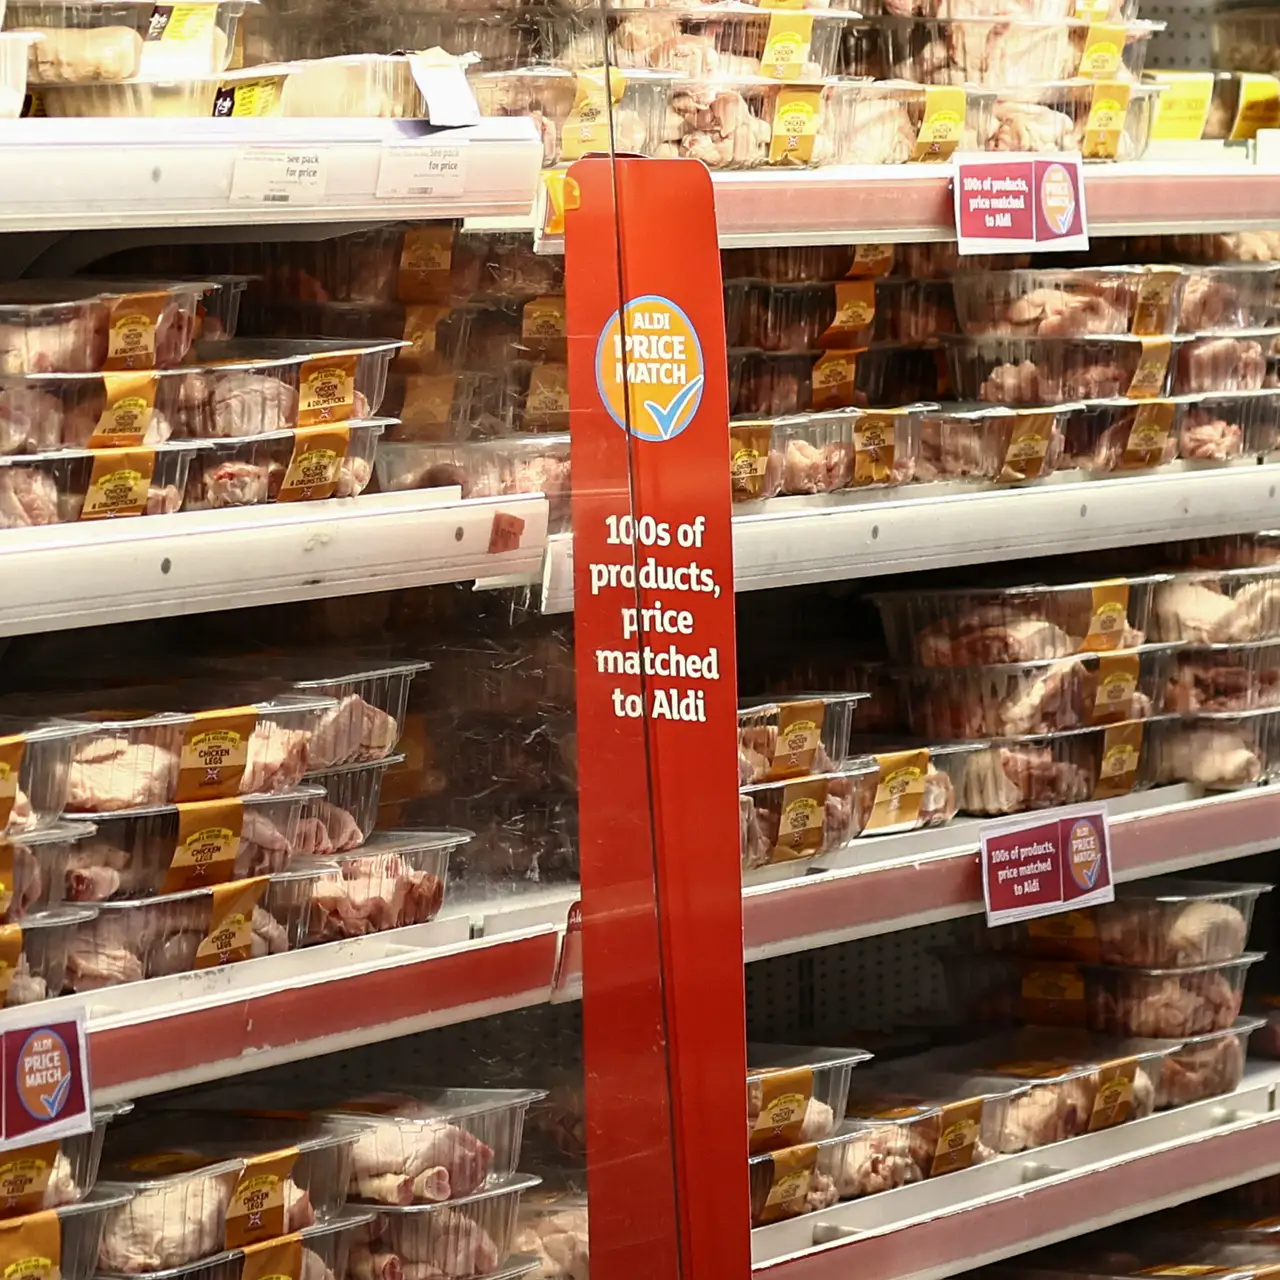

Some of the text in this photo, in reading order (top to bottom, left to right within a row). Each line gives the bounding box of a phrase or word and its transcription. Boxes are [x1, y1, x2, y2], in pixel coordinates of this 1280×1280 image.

[302, 154, 319, 165] pack
[429, 161, 458, 172] for price
[286, 168, 317, 179] for price
[963, 177, 1029, 194] 100s of products,
[969, 195, 1025, 212] price matched
[985, 213, 1012, 227] to Aldi
[633, 312, 670, 329] ALDI
[613, 334, 686, 360] PRICE
[616, 362, 687, 385] MATCH
[314, 385, 338, 394] CHICKEN
[605, 514, 706, 548] 100s of
[589, 557, 721, 598] products,
[621, 600, 694, 640] price
[595, 645, 720, 680] matched
[612, 687, 707, 722] to Aldi
[198, 748, 230, 758] CHICKEN
[191, 845, 221, 857] CHICKEN
[992, 841, 1056, 863] 100s of products,
[1072, 837, 1095, 852] PRICE
[1074, 851, 1096, 863] MATCH
[998, 858, 1052, 884] price matched
[1014, 878, 1040, 896] to Aldi
[211, 931, 236, 943] CHICKEN
[32, 1038, 52, 1053] ALDI
[24, 1051, 61, 1072] PRICE
[26, 1068, 61, 1088] MATCH
[243, 1192, 269, 1205] CHICKEN
